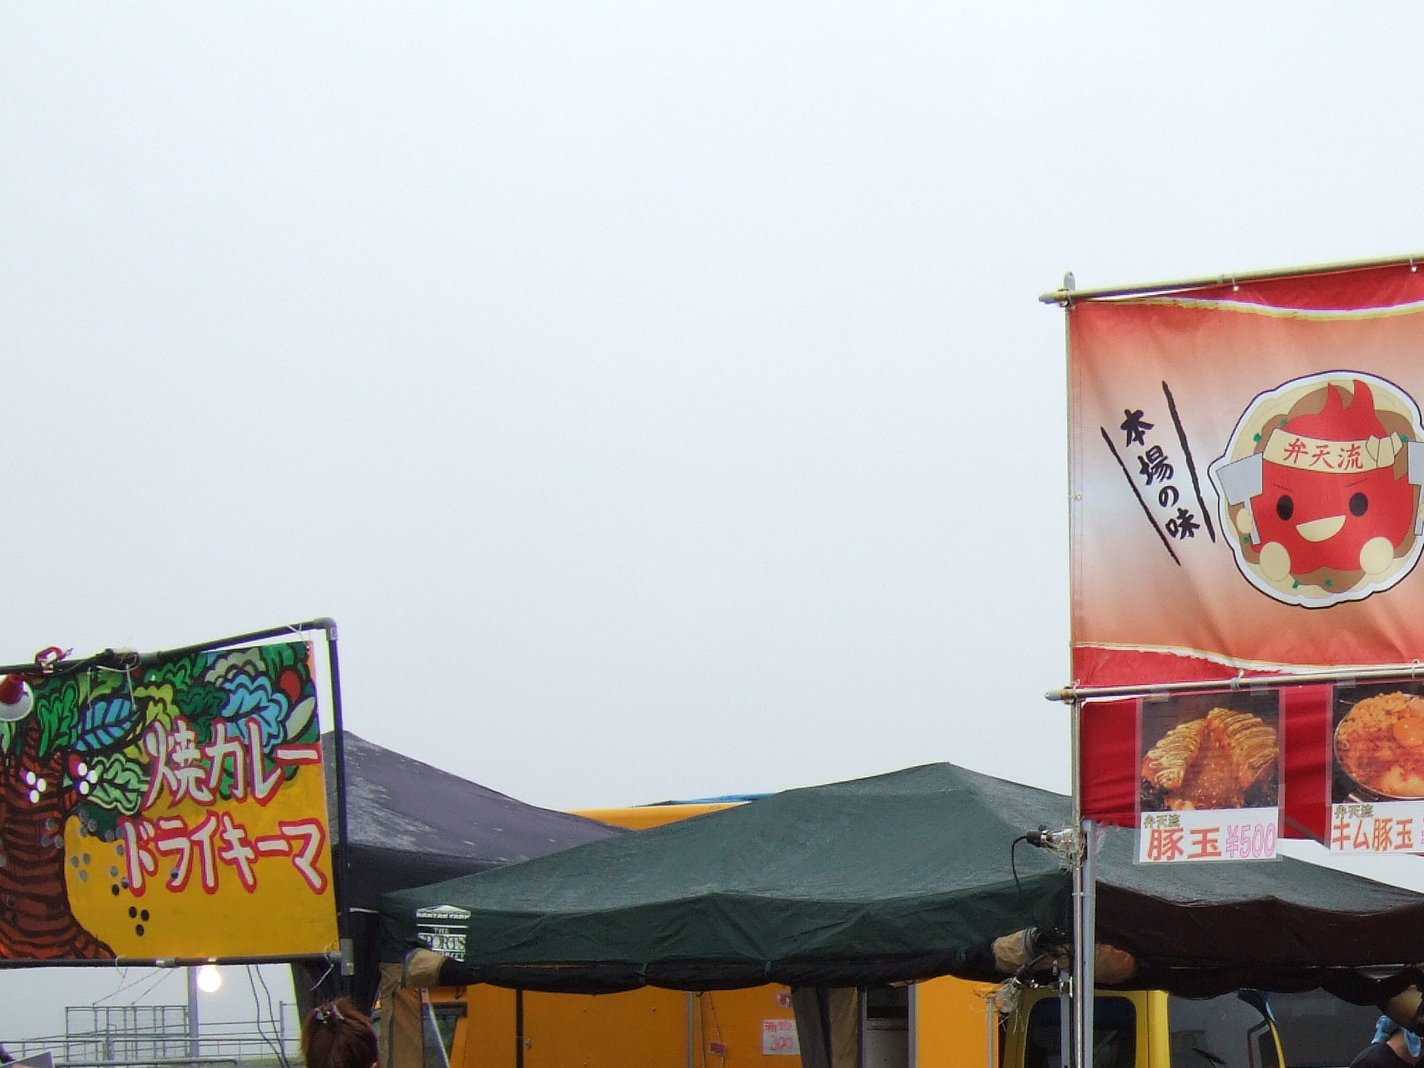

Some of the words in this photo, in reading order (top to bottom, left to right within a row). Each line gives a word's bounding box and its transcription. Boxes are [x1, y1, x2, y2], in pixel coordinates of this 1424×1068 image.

[1120, 409, 1201, 539] 本場の味
[1283, 438, 1363, 470] 弁天流
[140, 715, 321, 809] 焼カレー
[120, 812, 328, 896] ドライキーマ
[1147, 826, 1222, 861] 豚玉
[1226, 822, 1276, 858] ¥500
[1332, 818, 1413, 851] キム豚玉
